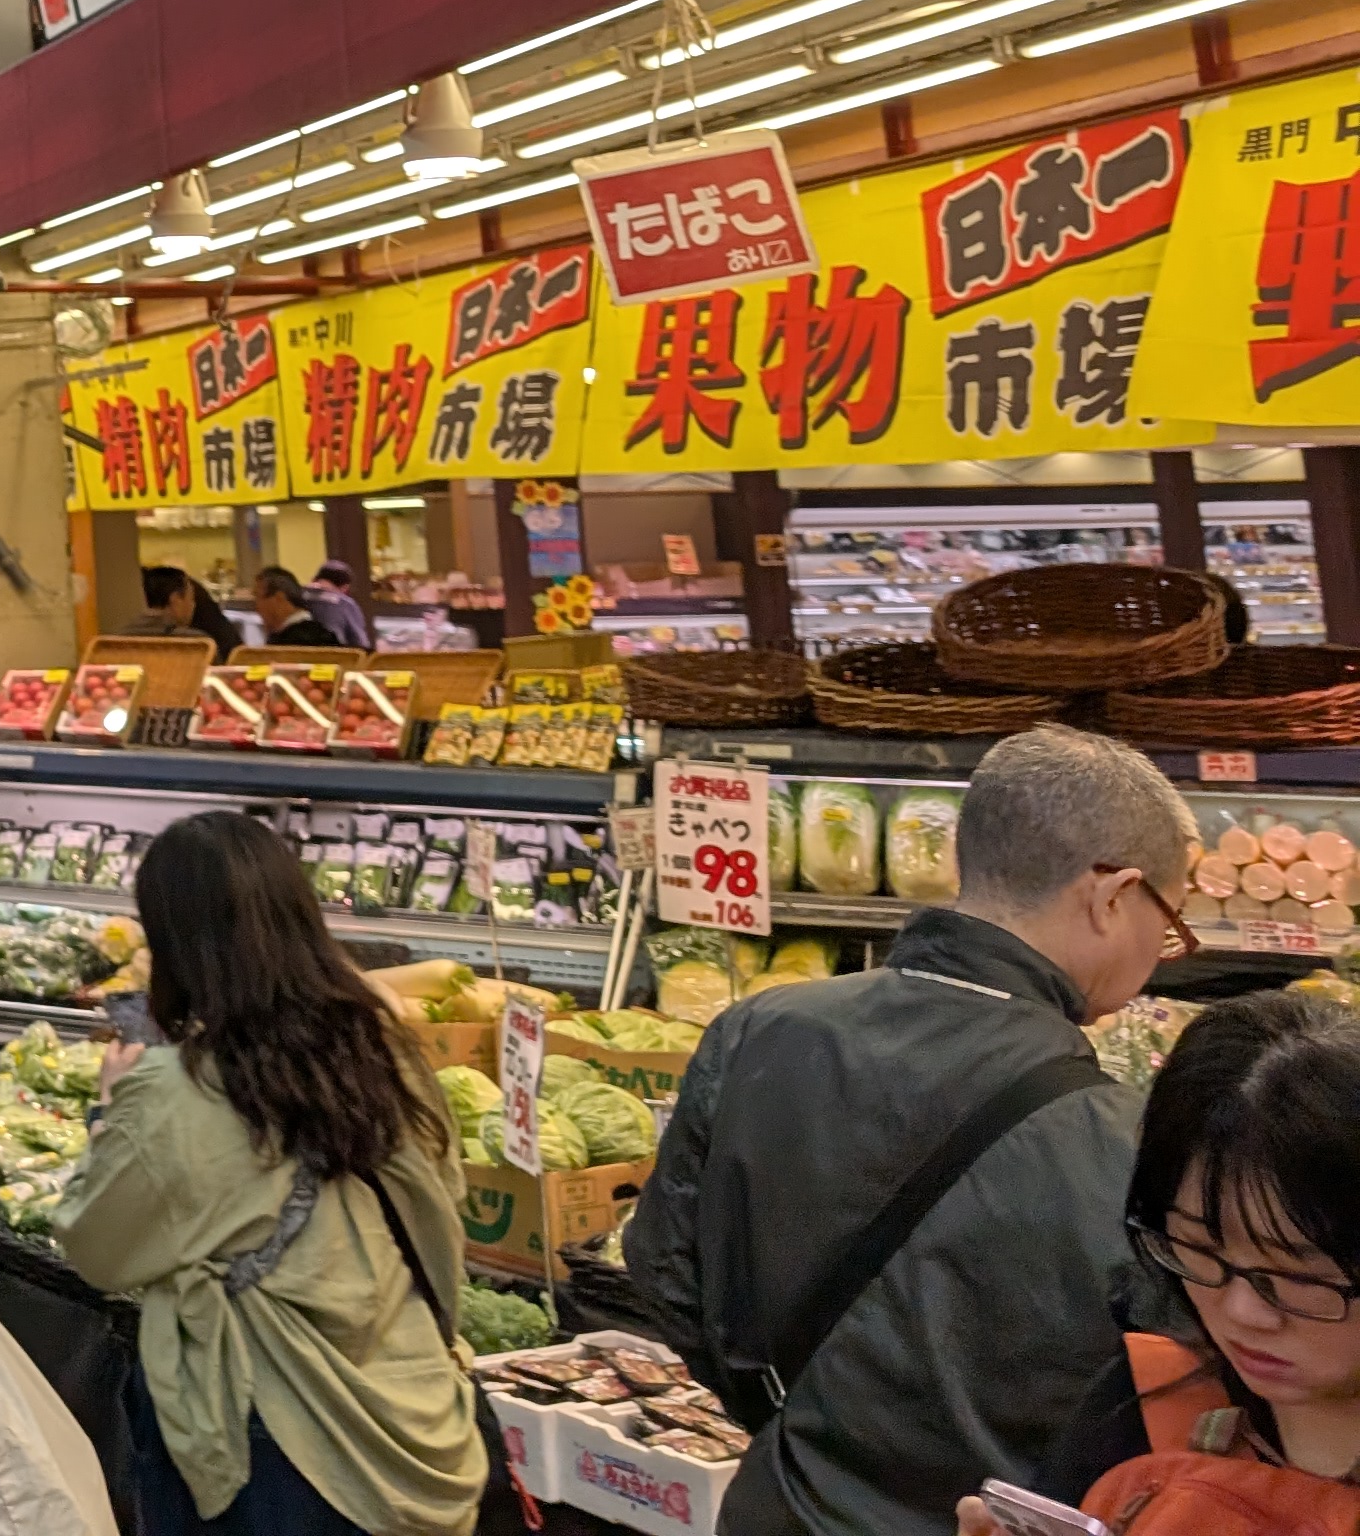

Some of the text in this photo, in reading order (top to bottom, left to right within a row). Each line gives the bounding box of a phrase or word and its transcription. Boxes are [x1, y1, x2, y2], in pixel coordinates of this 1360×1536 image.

[606, 178, 787, 260] たばこ
[942, 127, 1174, 297] 日本一
[452, 254, 583, 369] 日本一
[195, 324, 272, 414] 日本一
[625, 265, 912, 454] 果物
[947, 296, 1155, 436] 市場
[95, 388, 192, 499] 精肉
[203, 416, 277, 493] 市場
[302, 343, 431, 482] 精肉
[429, 370, 561, 465] 市場
[669, 813, 751, 842] きゃべつ
[695, 844, 758, 897] 98
[715, 900, 755, 928] 106
